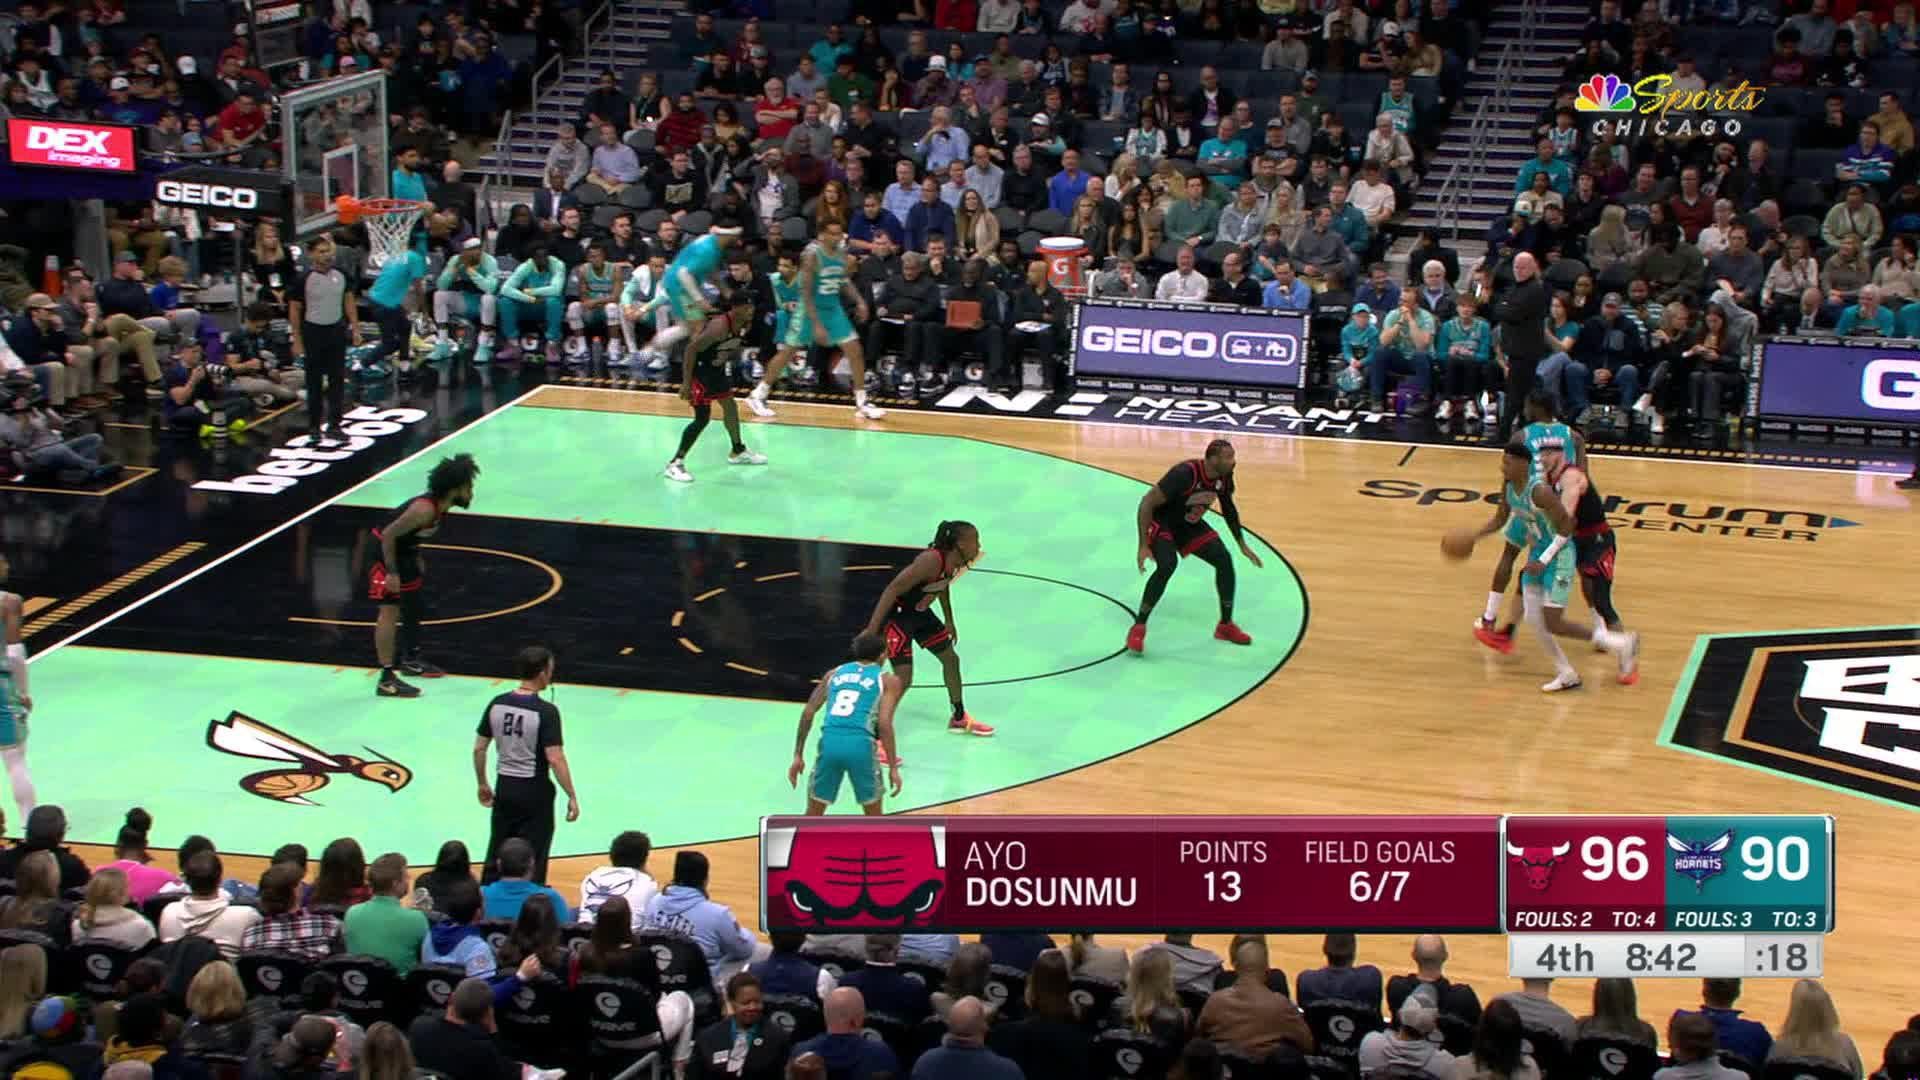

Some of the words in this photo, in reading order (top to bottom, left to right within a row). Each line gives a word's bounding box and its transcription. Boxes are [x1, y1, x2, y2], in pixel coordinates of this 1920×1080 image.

[27, 126, 112, 154] DEX
[48, 151, 120, 168] imaging
[157, 180, 258, 209] GEICO
[1082, 325, 1217, 358] GEICO
[1114, 407, 1358, 433] HEALTH
[1125, 396, 1397, 423] NOVANT
[830, 689, 860, 716] 8
[503, 713, 524, 737] 24
